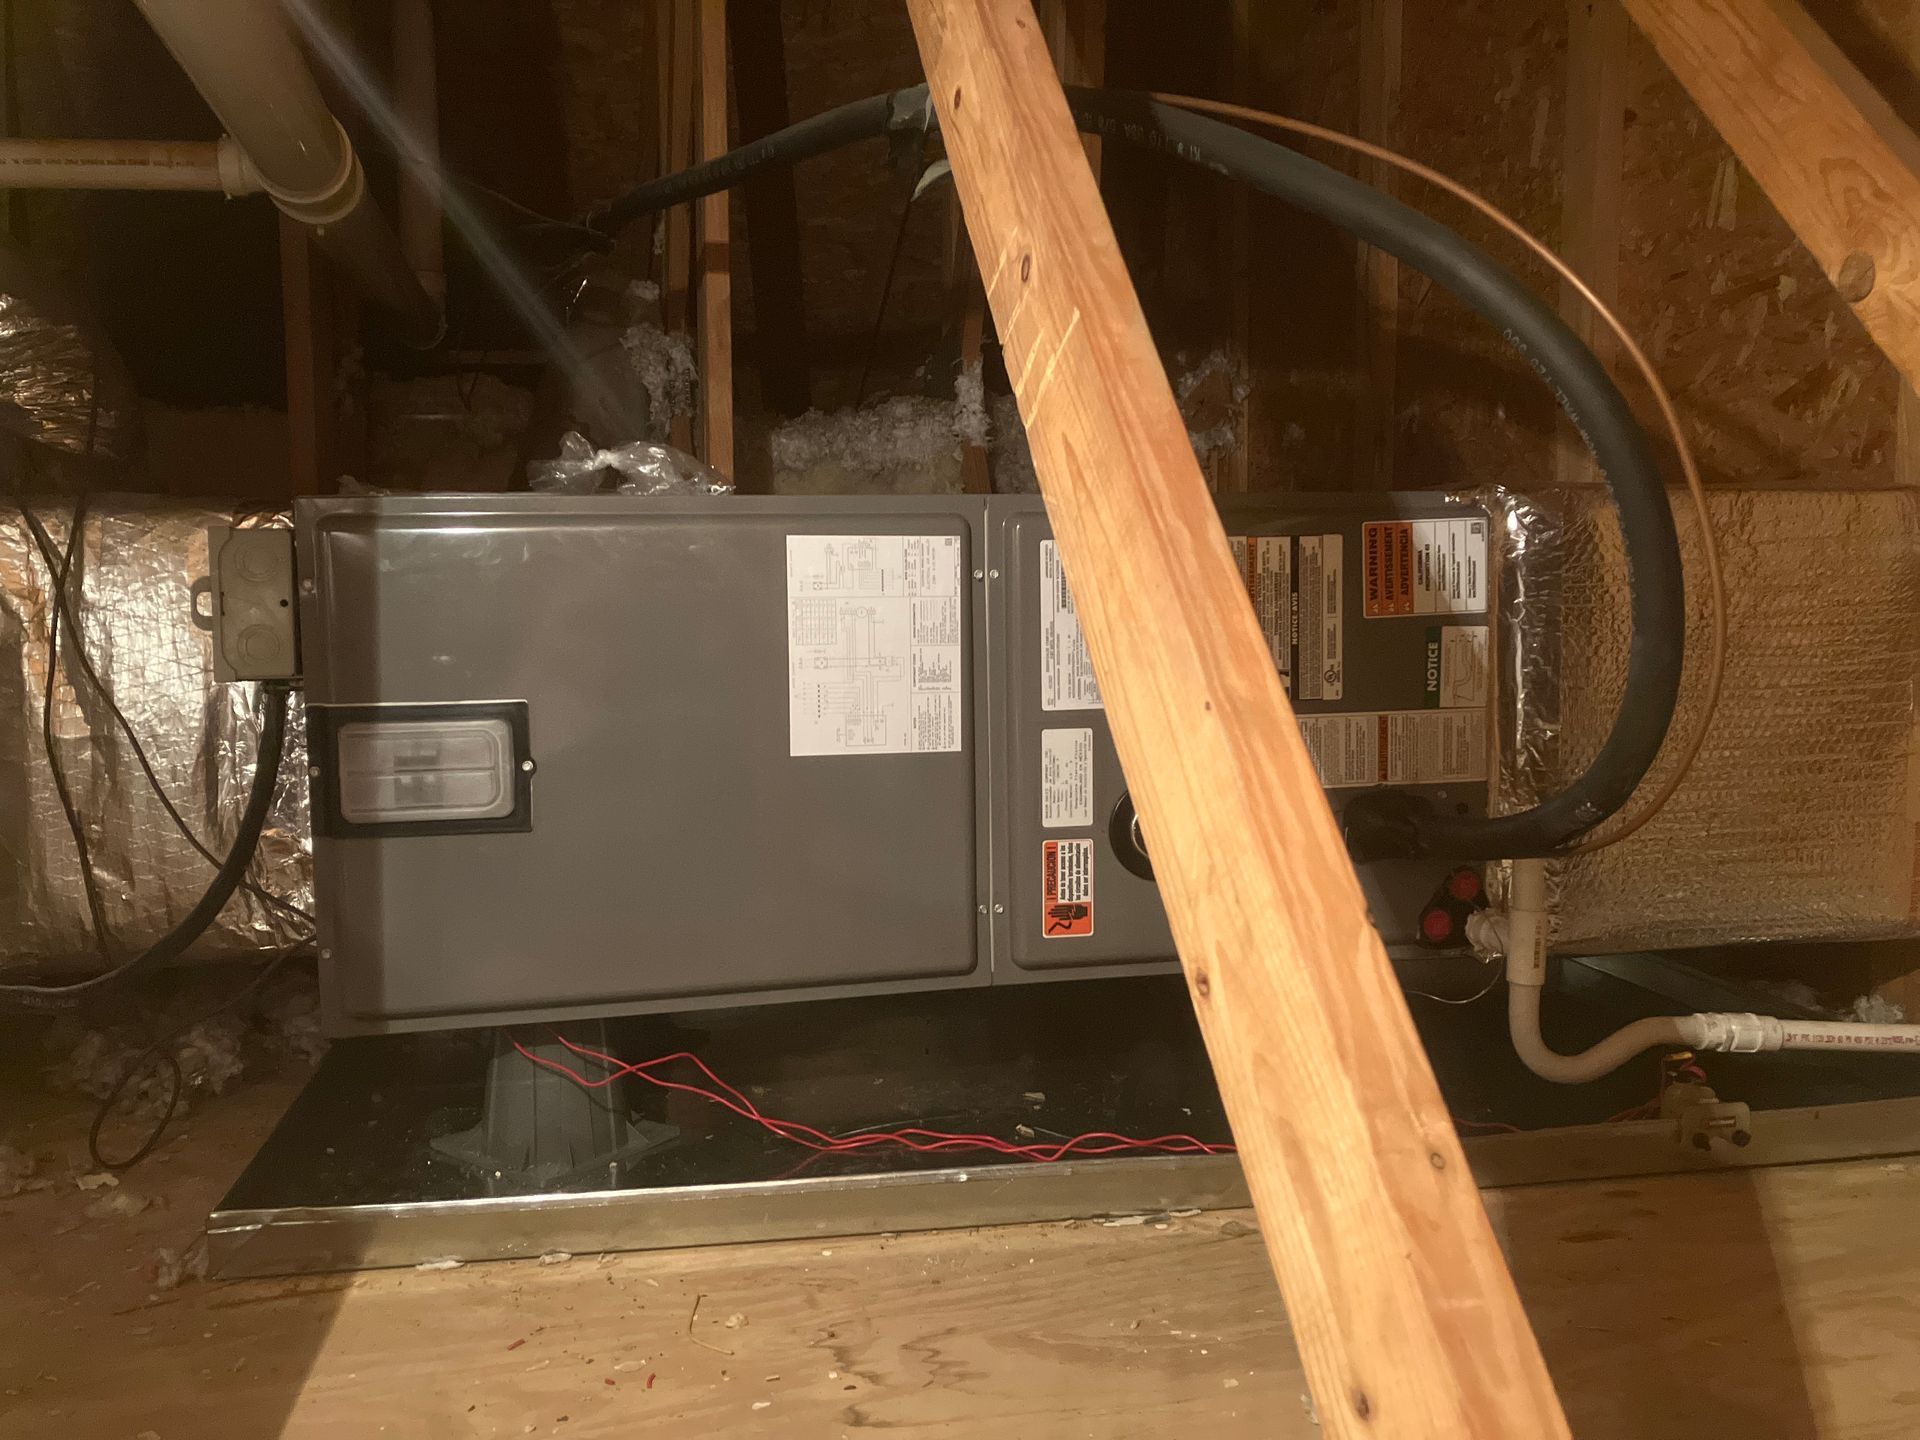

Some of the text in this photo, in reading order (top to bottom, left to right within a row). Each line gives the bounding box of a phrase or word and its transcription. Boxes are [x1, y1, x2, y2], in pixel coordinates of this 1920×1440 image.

[1368, 527, 1378, 601] WARNING
[1384, 527, 1394, 601] AVERTISSEMENT
[1399, 528, 1409, 596] ADVERTENCIA
[1427, 642, 1438, 691] NOTICE
